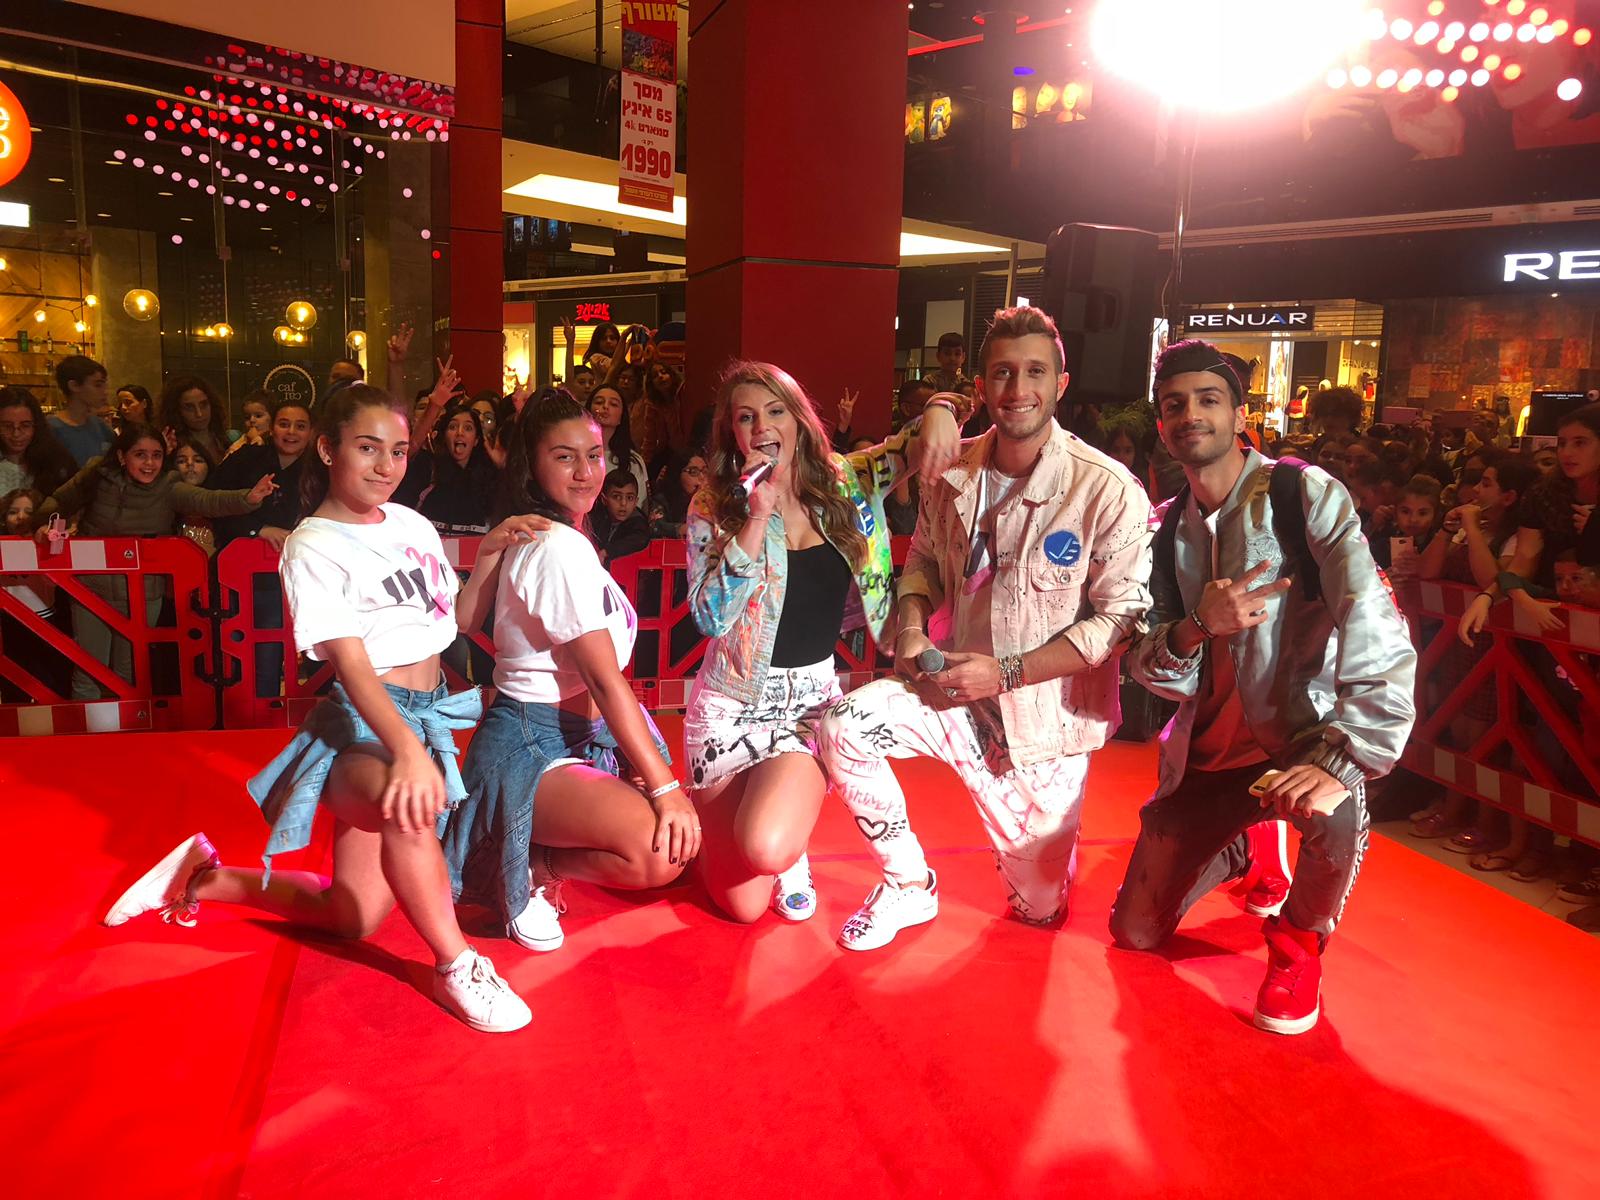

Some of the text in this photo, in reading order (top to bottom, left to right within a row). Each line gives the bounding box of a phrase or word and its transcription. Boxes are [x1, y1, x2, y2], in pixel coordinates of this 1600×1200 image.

[621, 2, 677, 24] מטורף
[633, 81, 662, 101] מסך
[656, 108, 672, 123] 65
[638, 123, 669, 137] סמארט
[621, 143, 671, 178] 1990
[1504, 250, 1600, 281] RE
[1189, 312, 1308, 326] RENUAR
